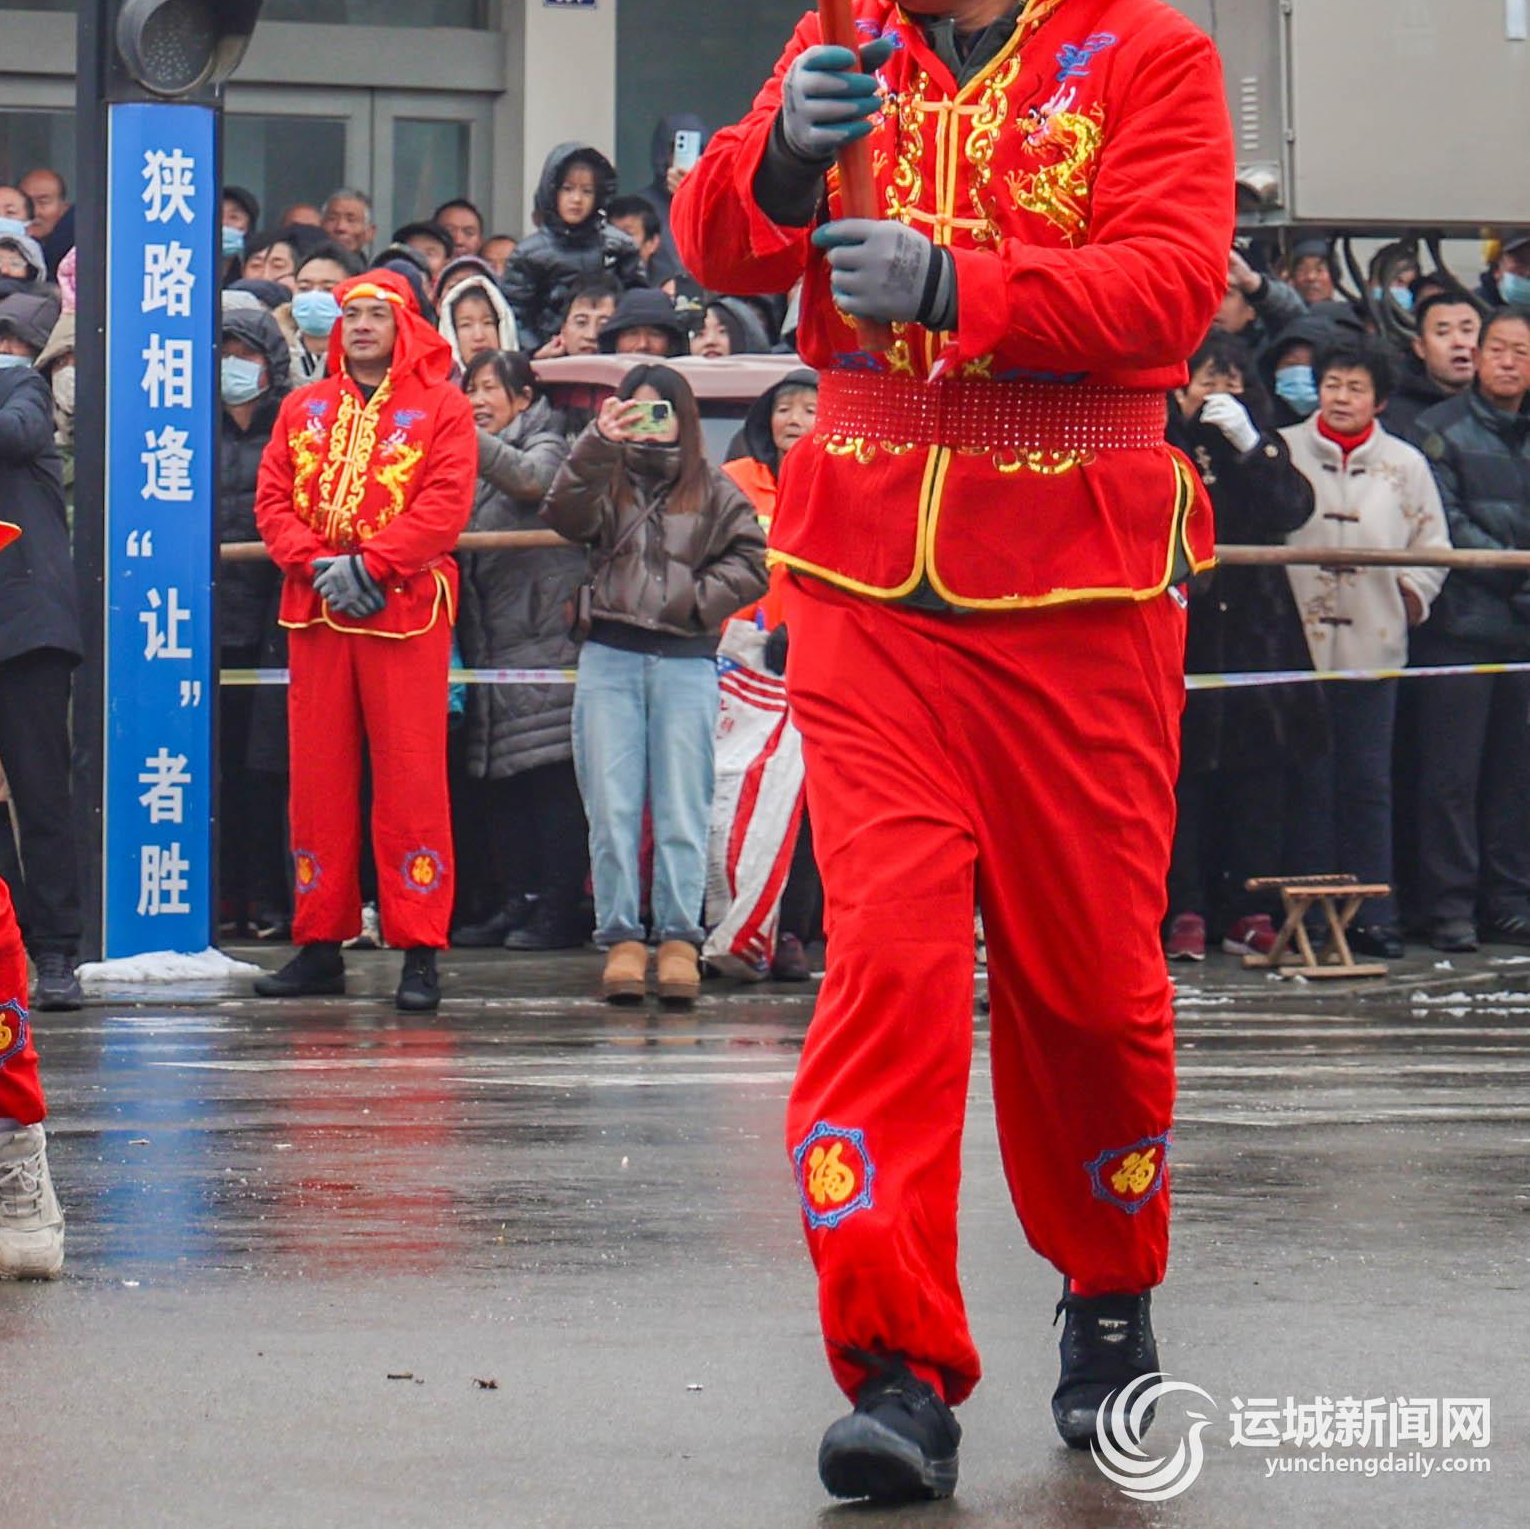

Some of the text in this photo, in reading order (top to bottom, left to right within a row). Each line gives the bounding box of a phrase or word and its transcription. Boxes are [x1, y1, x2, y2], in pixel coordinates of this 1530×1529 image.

[126, 149, 201, 917] 狭路相逢“让”者胜
[808, 1141, 855, 1204] 福
[1110, 1147, 1156, 1194] 福
